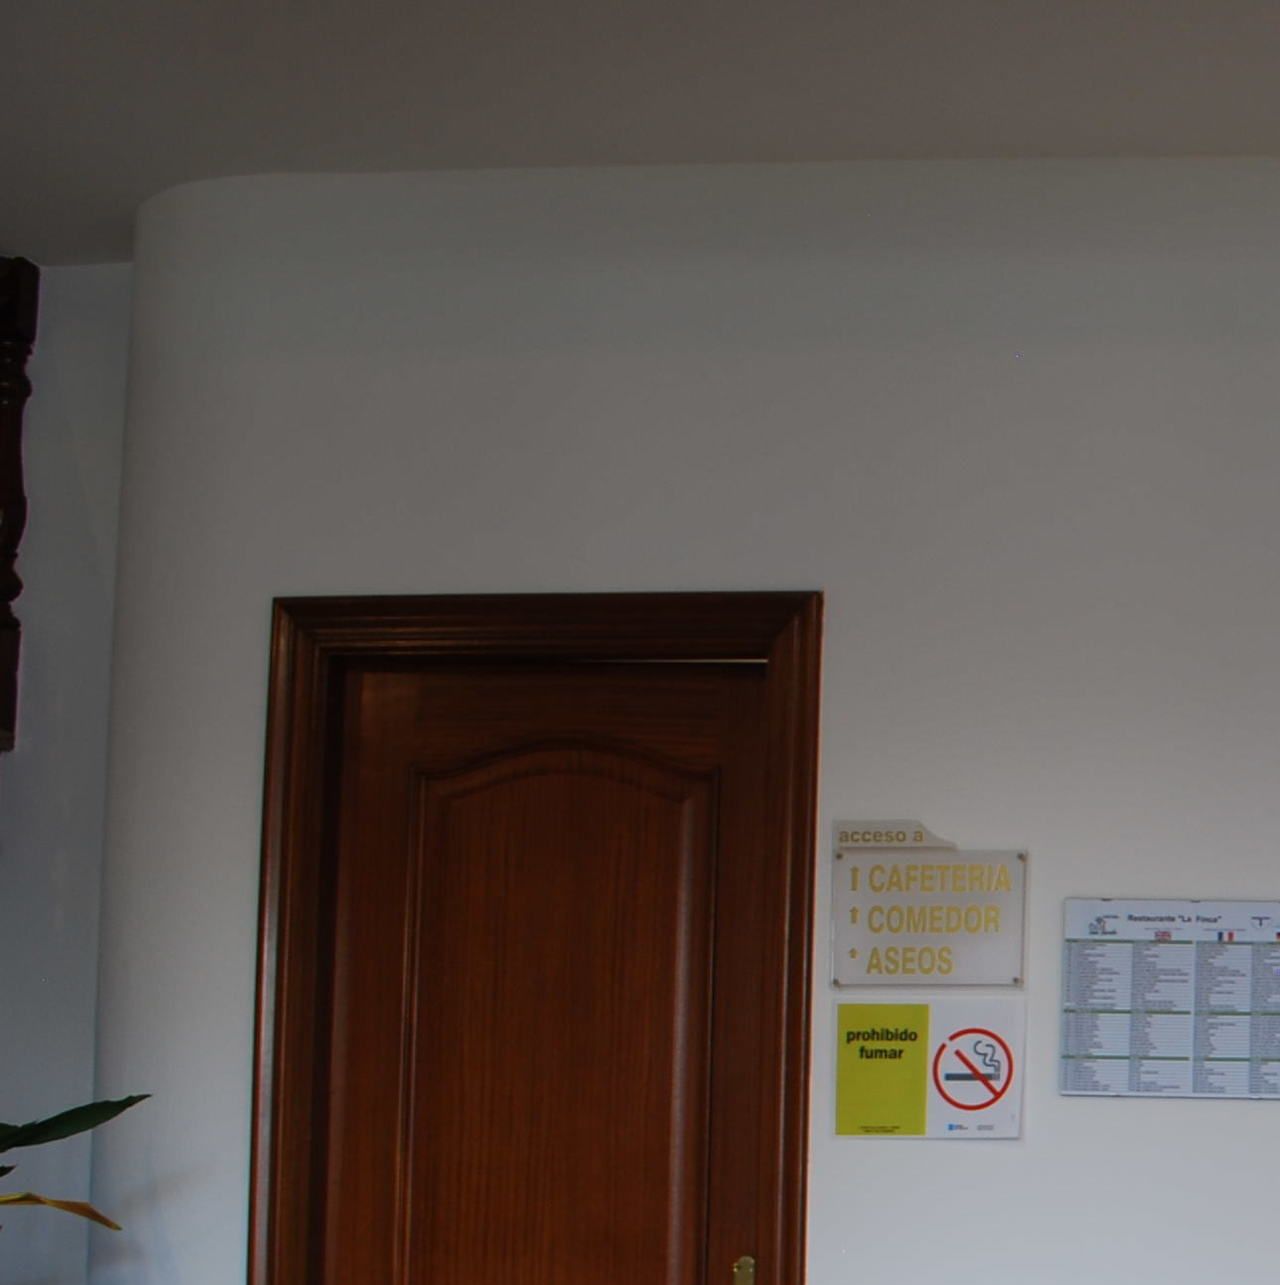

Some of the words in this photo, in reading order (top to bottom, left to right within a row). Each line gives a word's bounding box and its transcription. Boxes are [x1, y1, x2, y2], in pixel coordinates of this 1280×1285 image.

[838, 830, 906, 843] acceso
[913, 830, 924, 843] a
[868, 864, 1012, 893] CAFETERIA
[867, 905, 1001, 934] COMEDOR
[1127, 914, 1176, 924] Restaurante
[865, 946, 953, 975] ASEOS
[846, 1027, 918, 1045] prohibido
[858, 1046, 904, 1061] fumar
